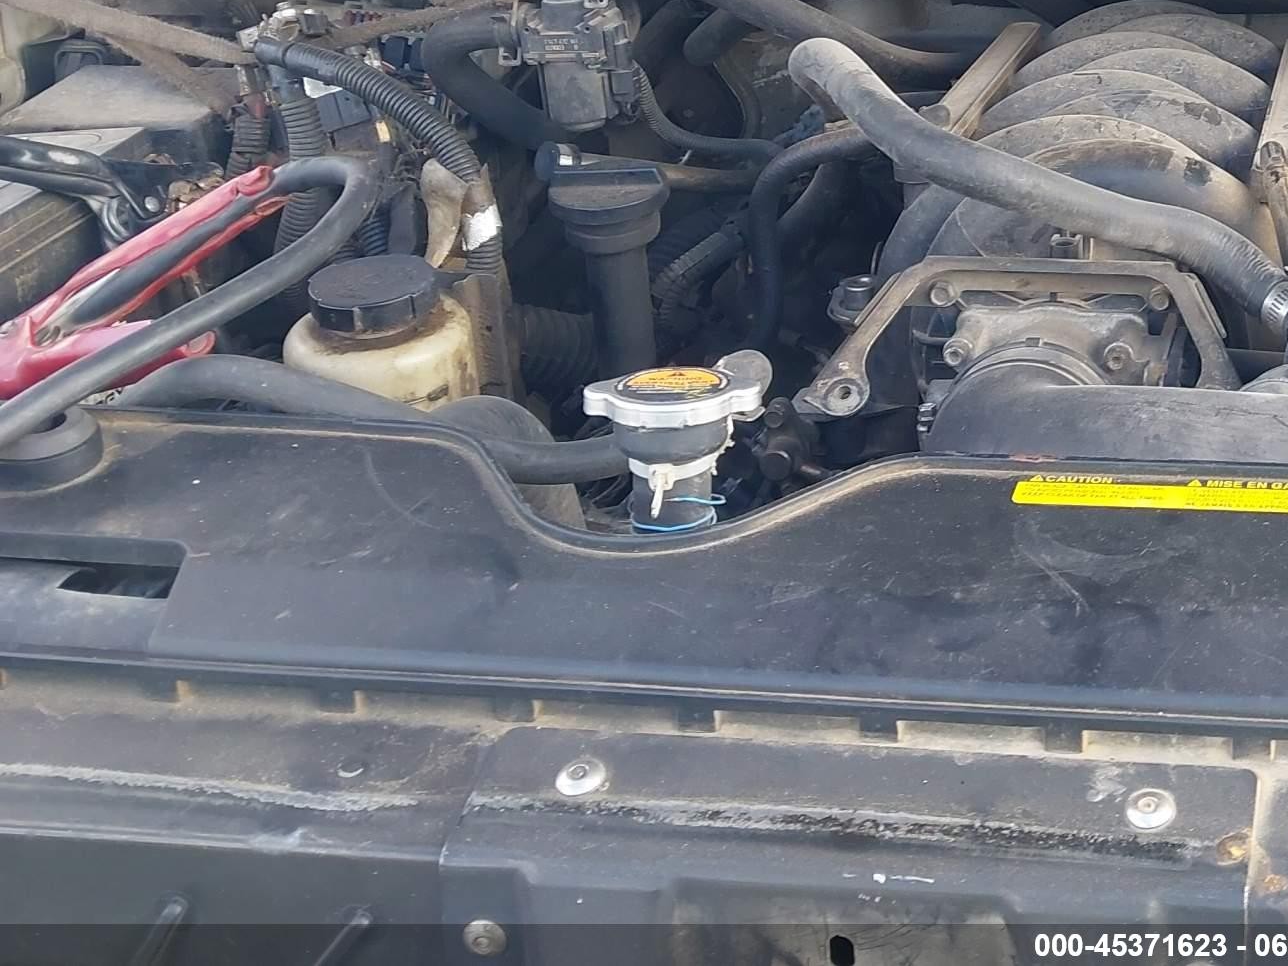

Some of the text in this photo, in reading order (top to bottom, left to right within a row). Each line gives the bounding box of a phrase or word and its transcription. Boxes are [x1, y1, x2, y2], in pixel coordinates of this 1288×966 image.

[1045, 475, 1113, 483] CAUTION
[1206, 480, 1243, 488] MISE
[1246, 481, 1268, 489] EN
